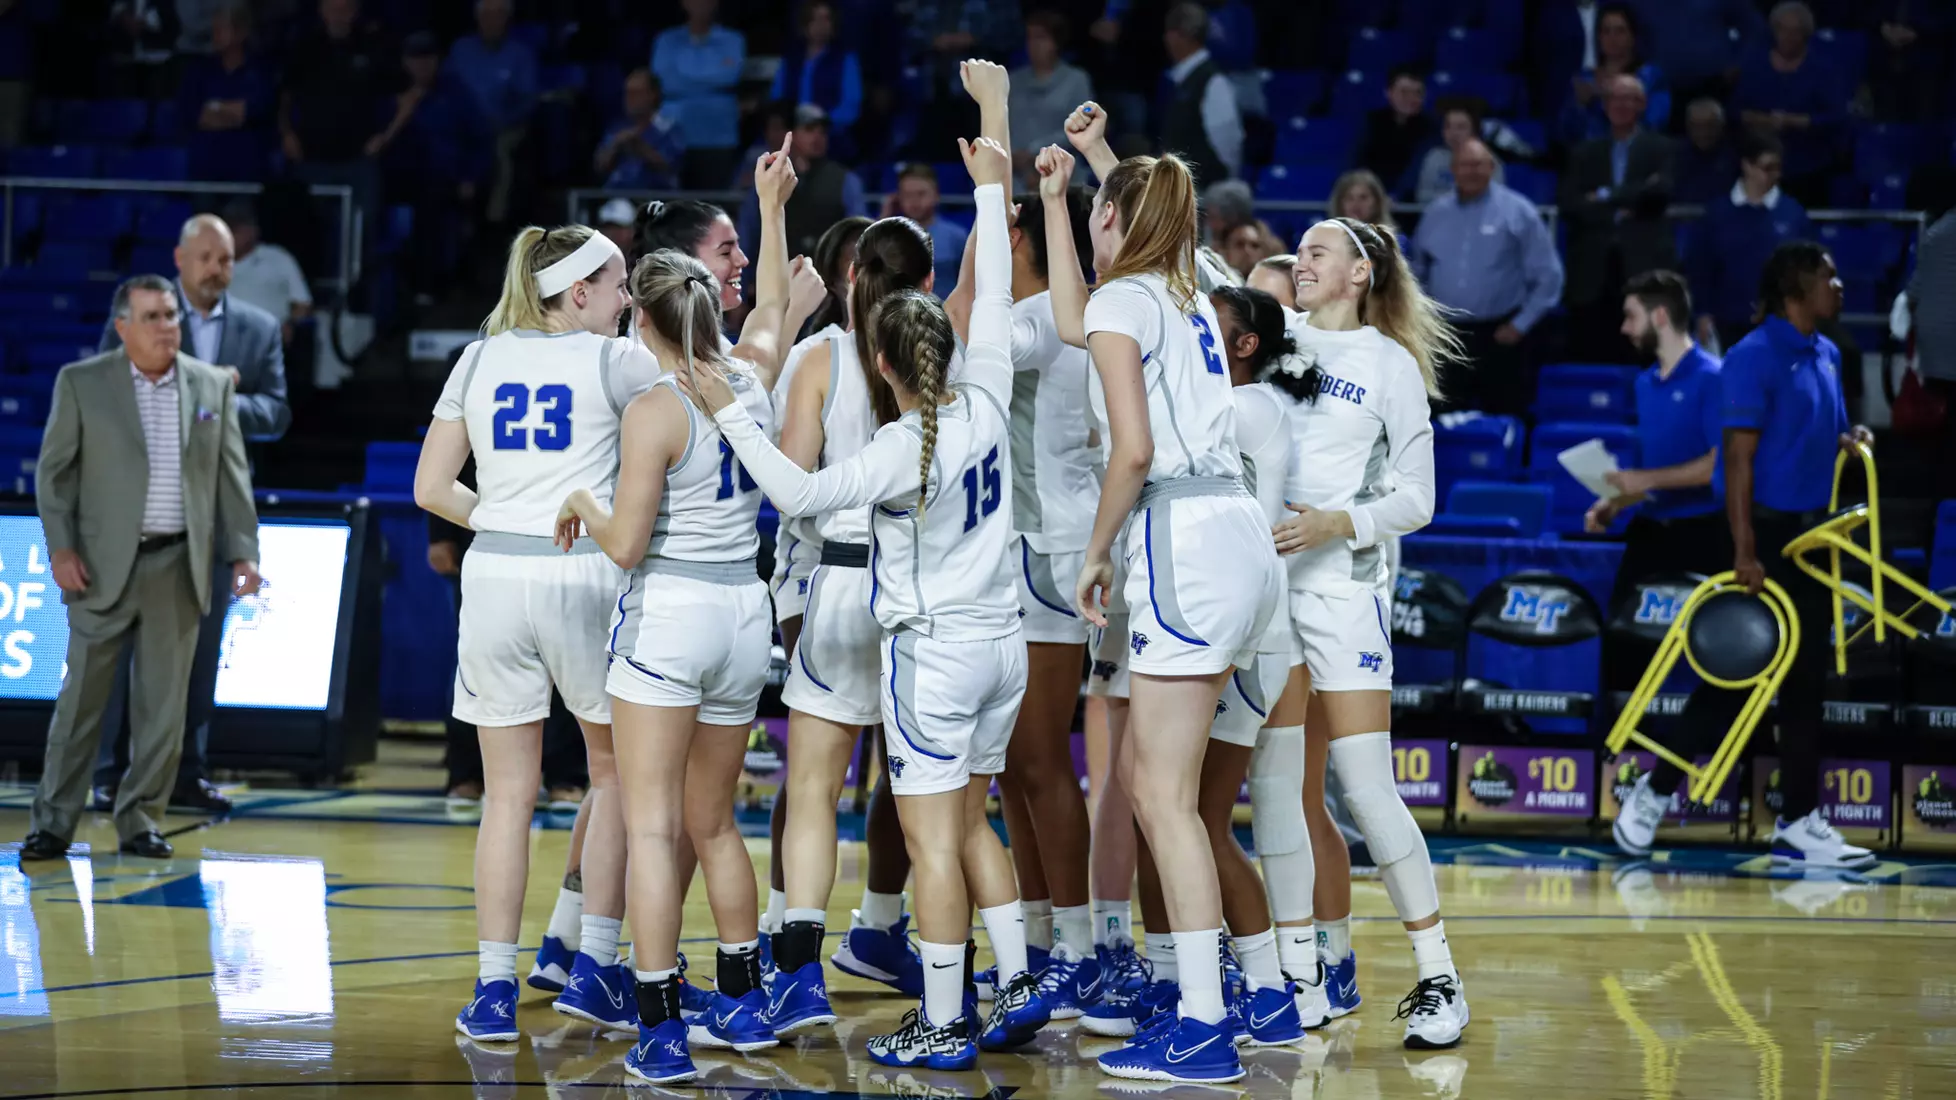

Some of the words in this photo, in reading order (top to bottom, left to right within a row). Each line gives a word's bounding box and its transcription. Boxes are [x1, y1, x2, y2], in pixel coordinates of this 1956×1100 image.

[1188, 312, 1224, 375] 2
[492, 382, 574, 452] 23
[962, 443, 1001, 534] 15
[1501, 585, 1570, 634] MT
[1358, 651, 1382, 673] MT
[1529, 756, 1577, 792] $10
[1824, 768, 1872, 804] $10
[1525, 791, 1536, 807] A
[1537, 792, 1586, 809] MONTH
[1834, 805, 1883, 821] MONTH
